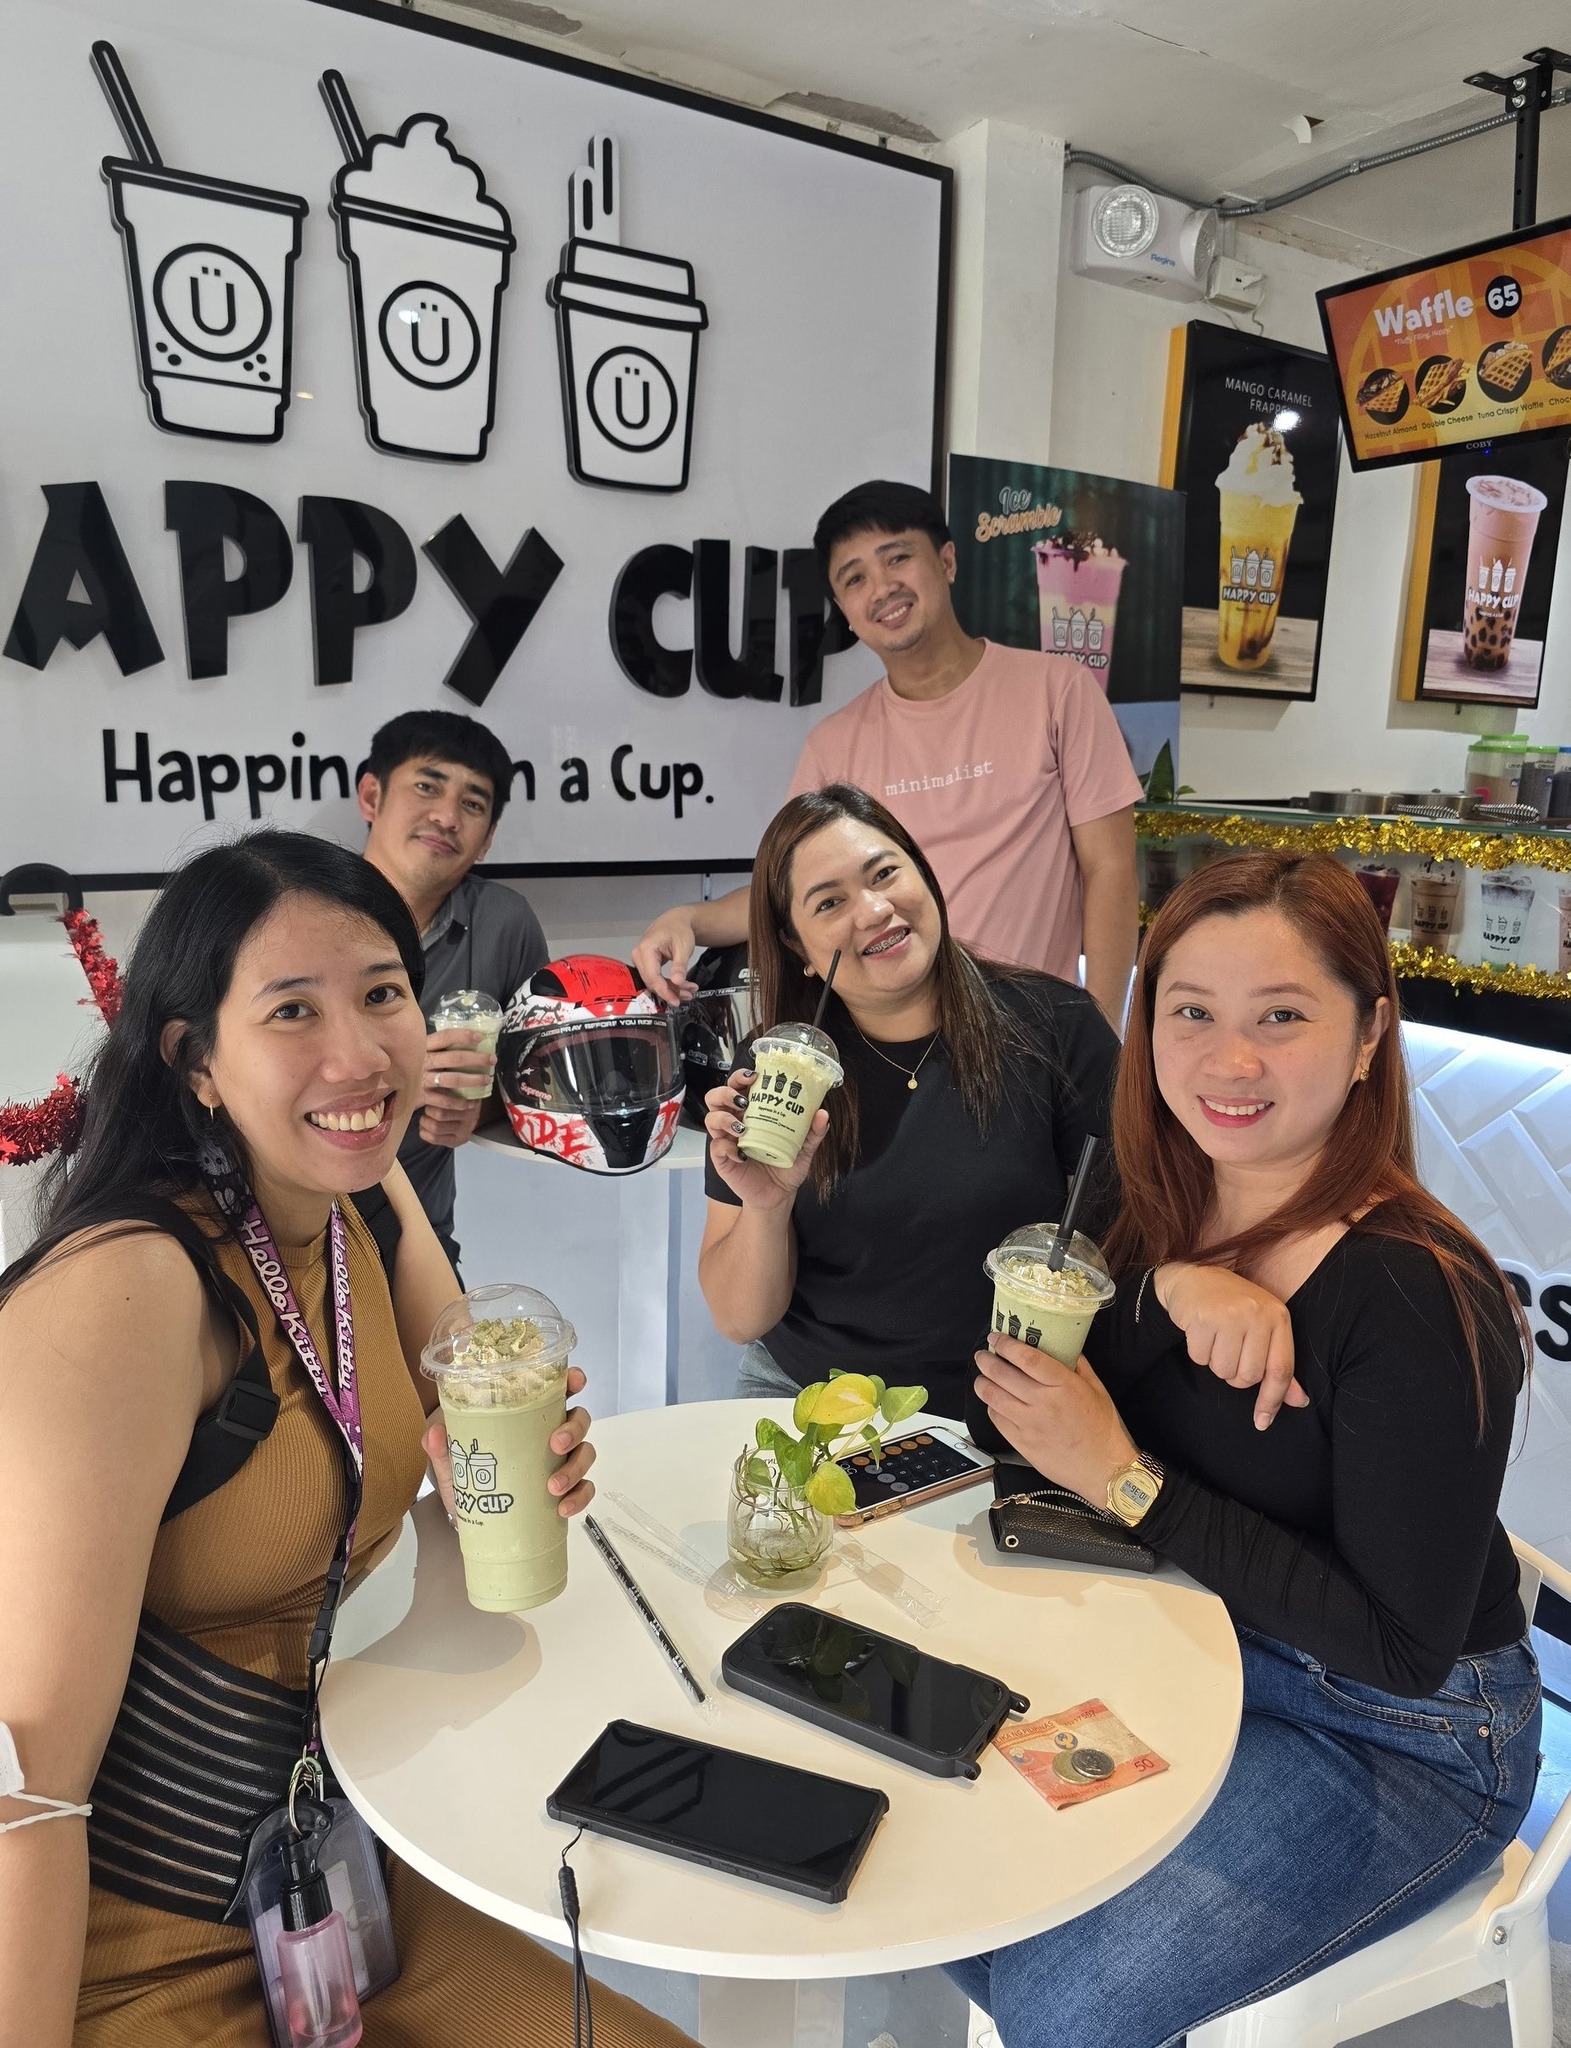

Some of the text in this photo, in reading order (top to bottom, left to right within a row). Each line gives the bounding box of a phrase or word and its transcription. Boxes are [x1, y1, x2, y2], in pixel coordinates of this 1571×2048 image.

[1374, 283, 1519, 337] Waffle 65
[1225, 377, 1312, 407] MANGO CARAMEL
[1477, 401, 1544, 420] Tuna Crispy Waffle
[1364, 424, 1418, 440] Hazelnut Almond
[1421, 414, 1473, 430] Double Cheese
[1466, 440, 1493, 450] COBY
[999, 486, 1032, 515] Ice
[975, 503, 1063, 543] Scramble
[1222, 586, 1277, 605] HAPPY CUP
[1468, 588, 1519, 609] HAPPY CUP
[608, 538, 858, 707] CUP
[1087, 653, 1109, 669] CUP
[102, 728, 716, 820] Happin n a Cup.
[884, 760, 994, 797] minimalist
[1483, 932, 1521, 944] HAPPY CUP
[560, 1024, 582, 1034] PRAY
[520, 1081, 553, 1101] Supreme
[751, 1092, 784, 1107] HAPPY
[785, 1101, 805, 1116] CUP
[242, 1218, 327, 1397] Hello Kitty
[333, 1224, 356, 1391] Hello Kitty
[477, 1493, 514, 1514] CUP
[1022, 1720, 1054, 1736] PILIPINAS
[1134, 1758, 1154, 1772] 50
